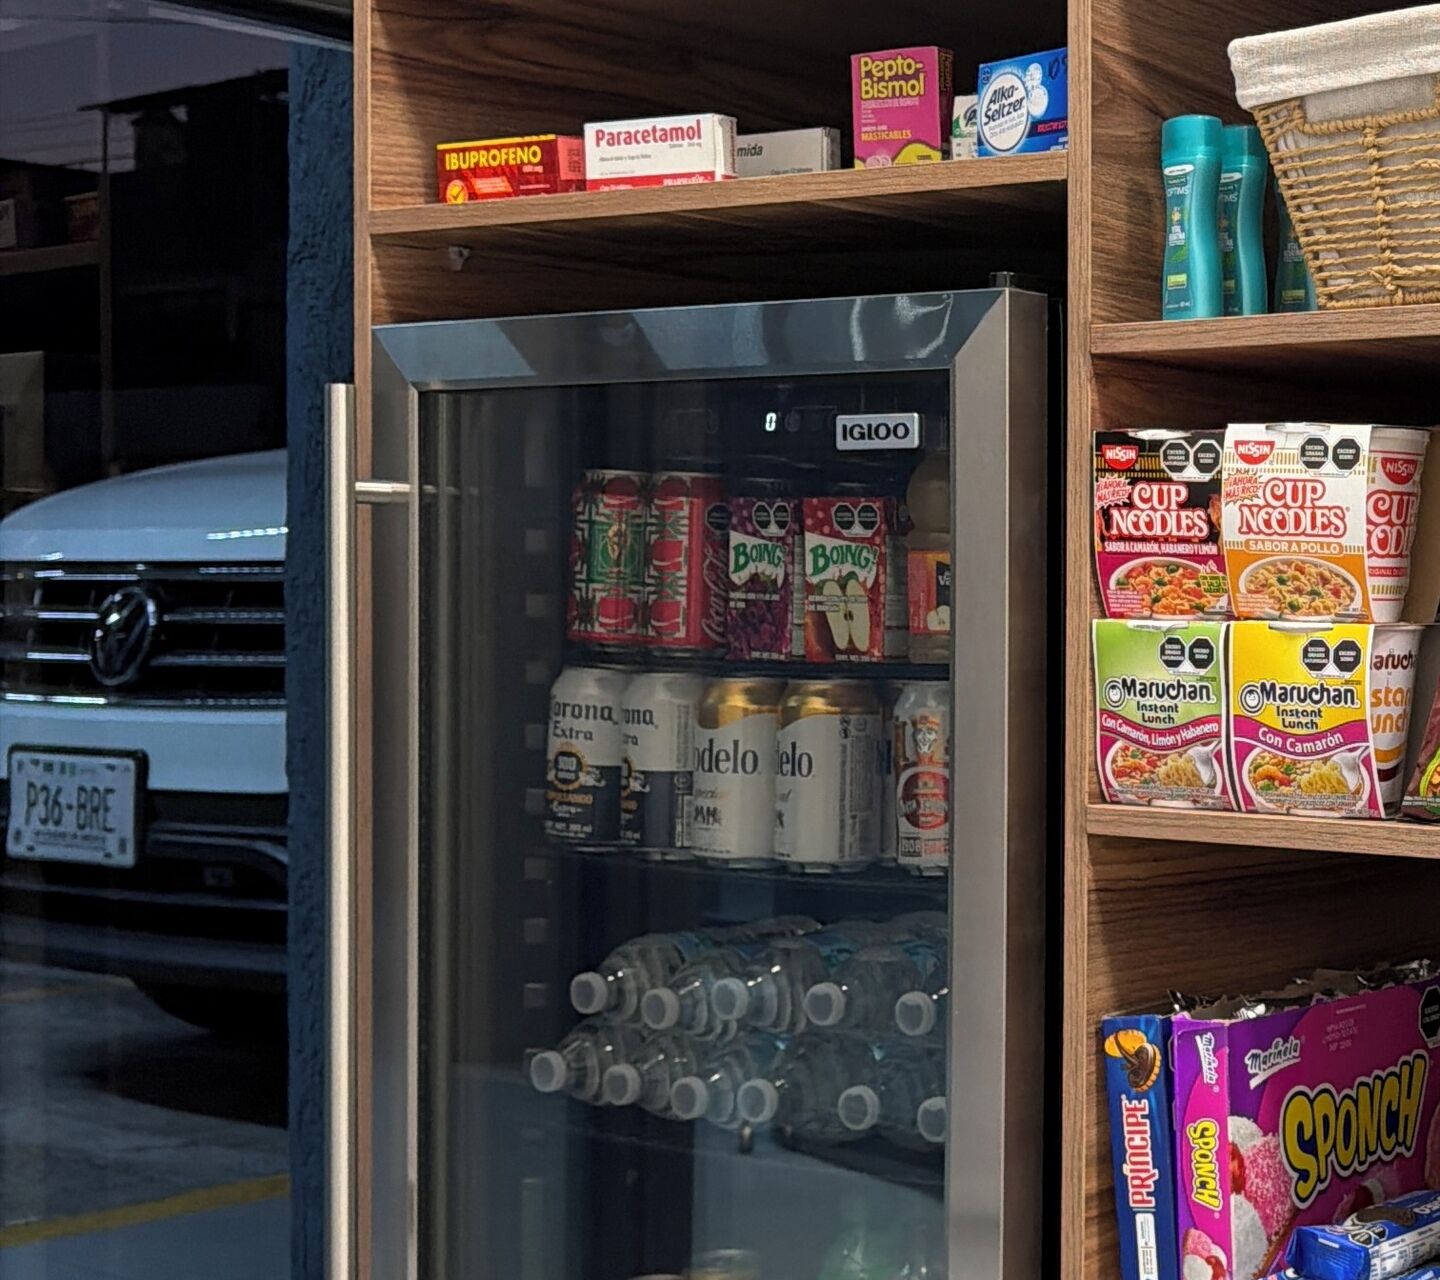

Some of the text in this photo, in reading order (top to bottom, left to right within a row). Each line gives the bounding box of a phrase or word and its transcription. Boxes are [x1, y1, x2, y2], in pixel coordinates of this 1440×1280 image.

[860, 55, 924, 80] Pepto-
[861, 72, 925, 99] Bismol
[986, 84, 1019, 109] Alka-
[983, 96, 1026, 127] Seltzer
[595, 119, 702, 148] Paracetamol
[445, 145, 542, 170] IBUPROFENO
[842, 422, 910, 441] IGLOO
[1105, 446, 1136, 462] NISSIN
[1237, 442, 1271, 458] NISSIN
[1385, 461, 1416, 477] NISSIN
[1133, 482, 1188, 510] CUP
[1263, 477, 1326, 508] CUP
[1110, 507, 1209, 539] NOODLES
[1239, 504, 1347, 538] NOODLES
[1249, 540, 1340, 553] SABOR A POLLO
[808, 543, 879, 577] BOING!
[1121, 678, 1211, 702] Maruchan
[1259, 681, 1355, 706] Maruchan
[551, 701, 618, 725] orona
[1136, 701, 1179, 713] Instant
[1141, 713, 1176, 725] Lunch
[1276, 706, 1323, 718] Instant
[552, 720, 593, 741] Extra
[1101, 714, 1116, 729] Con
[1116, 718, 1151, 745] Camarón,
[1151, 732, 1176, 746] Limón
[1180, 722, 1219, 739] Habanero
[1281, 718, 1319, 730] Lunch
[1258, 727, 1344, 754] Con Camarón
[25, 780, 117, 832] P36-BRE
[1202, 1033, 1218, 1083] Marinela
[1248, 1037, 1300, 1072] Marinela
[1283, 1052, 1428, 1207] SPONCH
[1189, 1120, 1222, 1209] SPONCH
